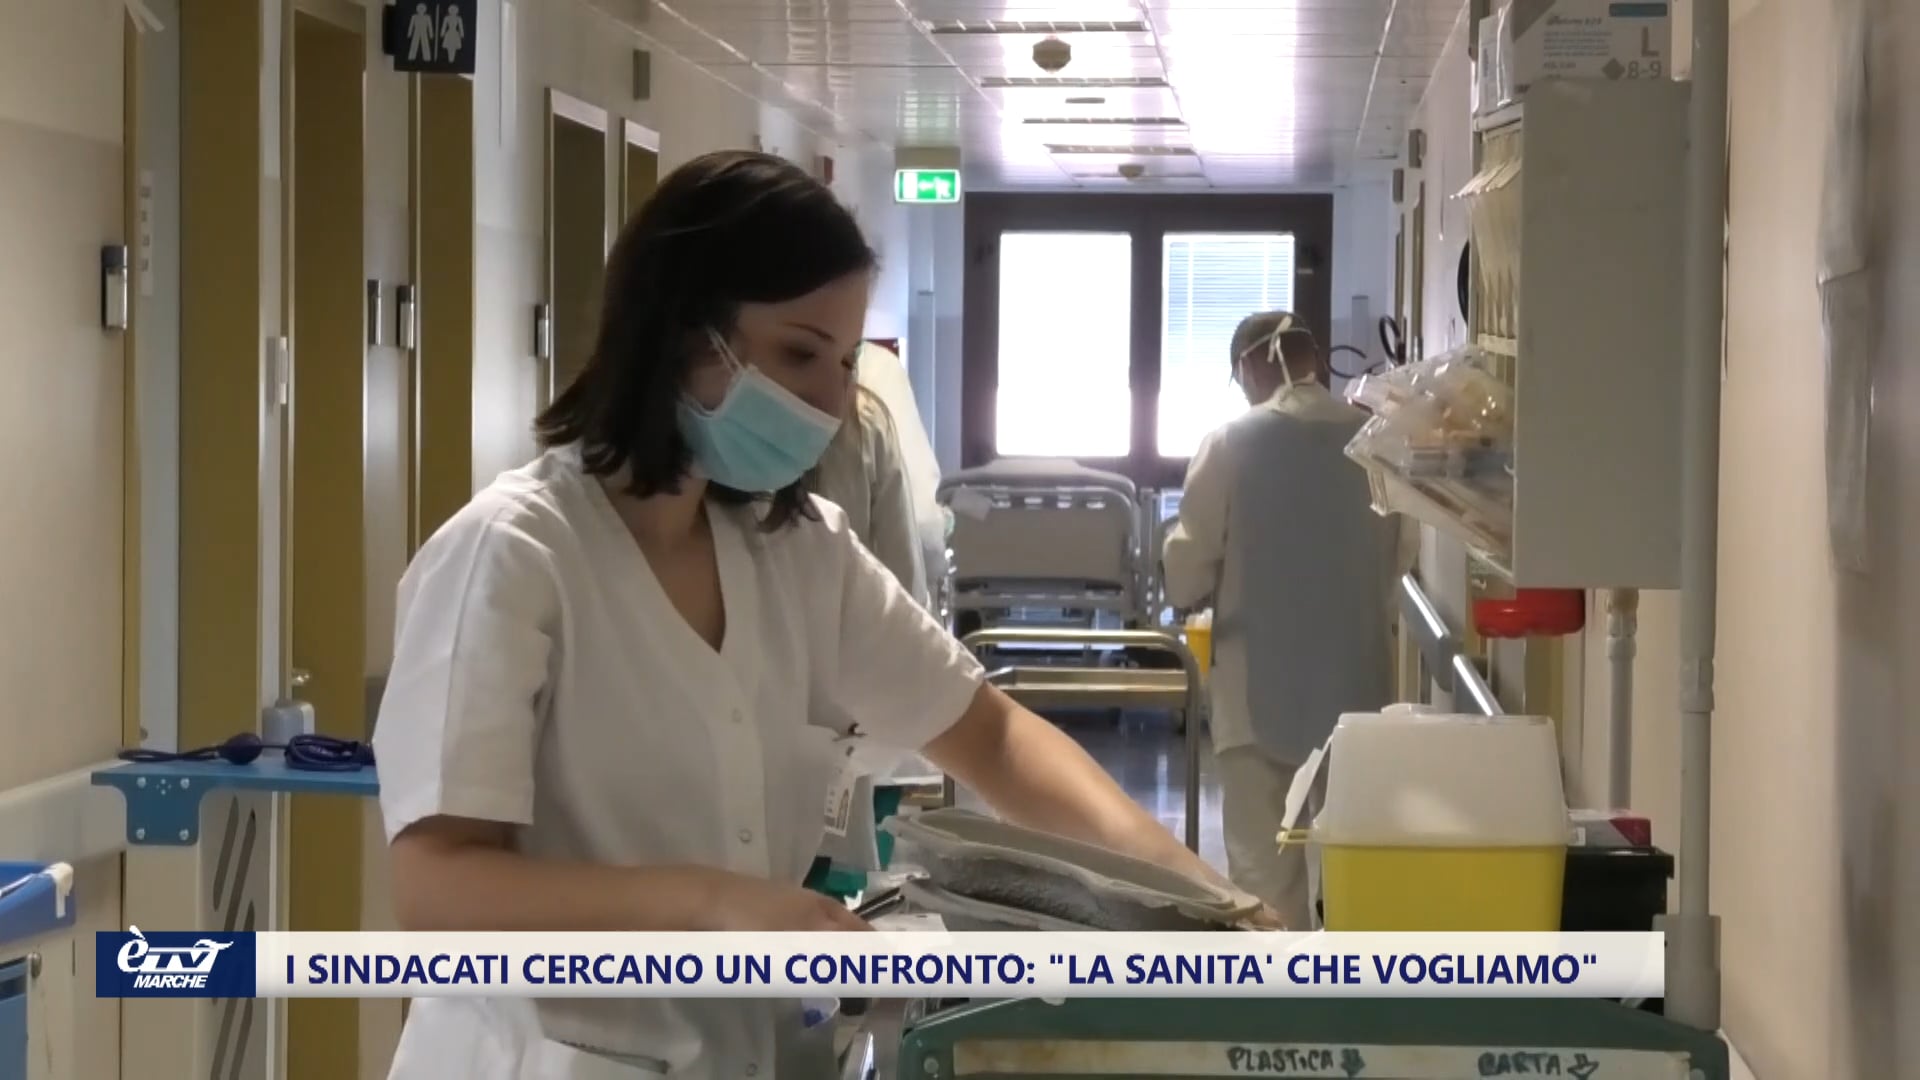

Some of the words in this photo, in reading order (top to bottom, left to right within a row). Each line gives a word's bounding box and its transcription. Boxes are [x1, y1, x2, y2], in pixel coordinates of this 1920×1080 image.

[1641, 25, 1660, 58] L
[1627, 60, 1662, 80] 8-9
[1478, 1051, 1561, 1076] CARTA
